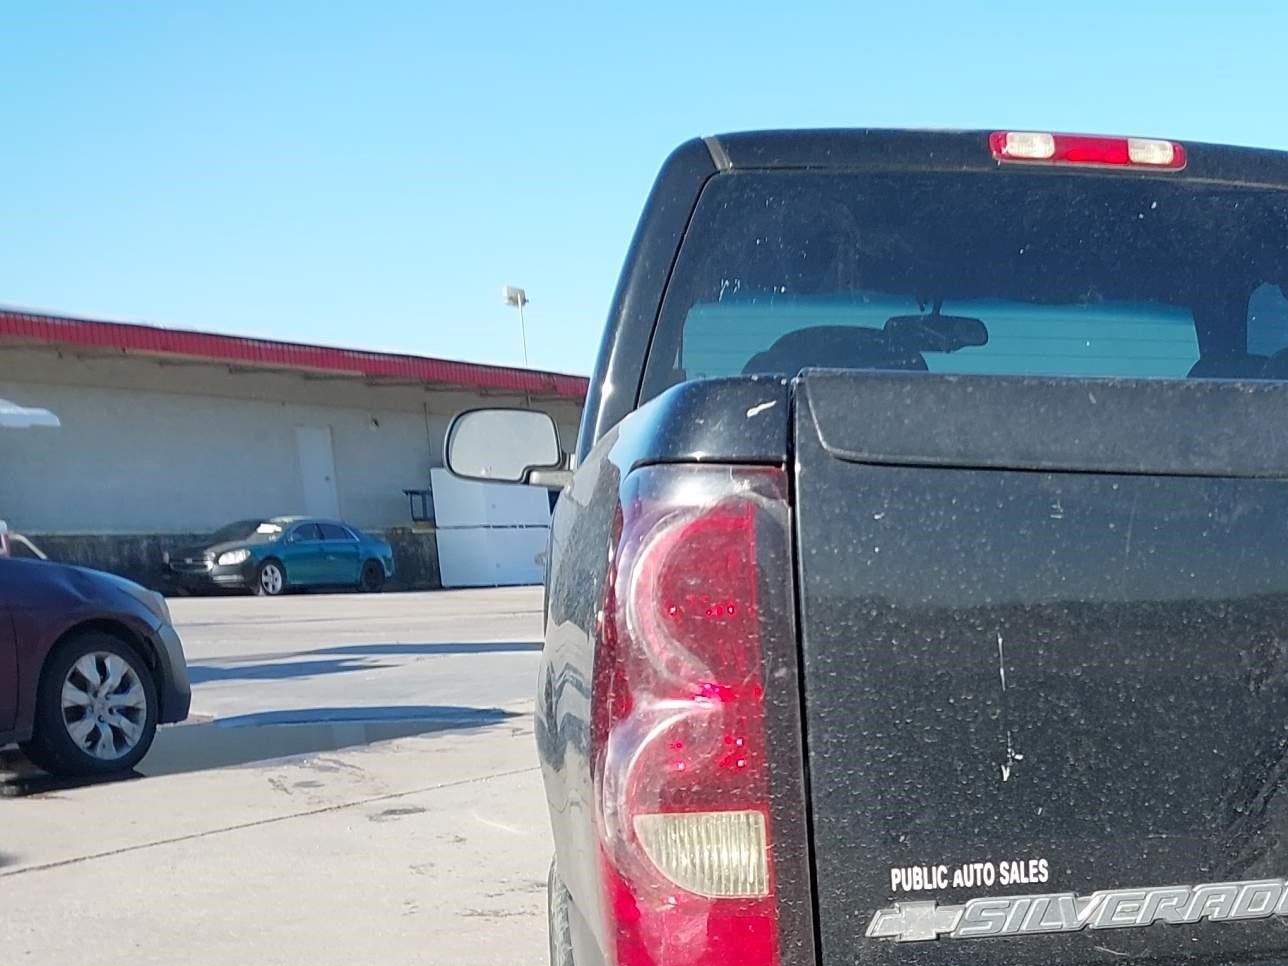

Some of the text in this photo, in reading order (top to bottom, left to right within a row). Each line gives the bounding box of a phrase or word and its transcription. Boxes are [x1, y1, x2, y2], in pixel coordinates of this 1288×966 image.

[890, 858, 1049, 892] PUBLIC AUTO SALES
